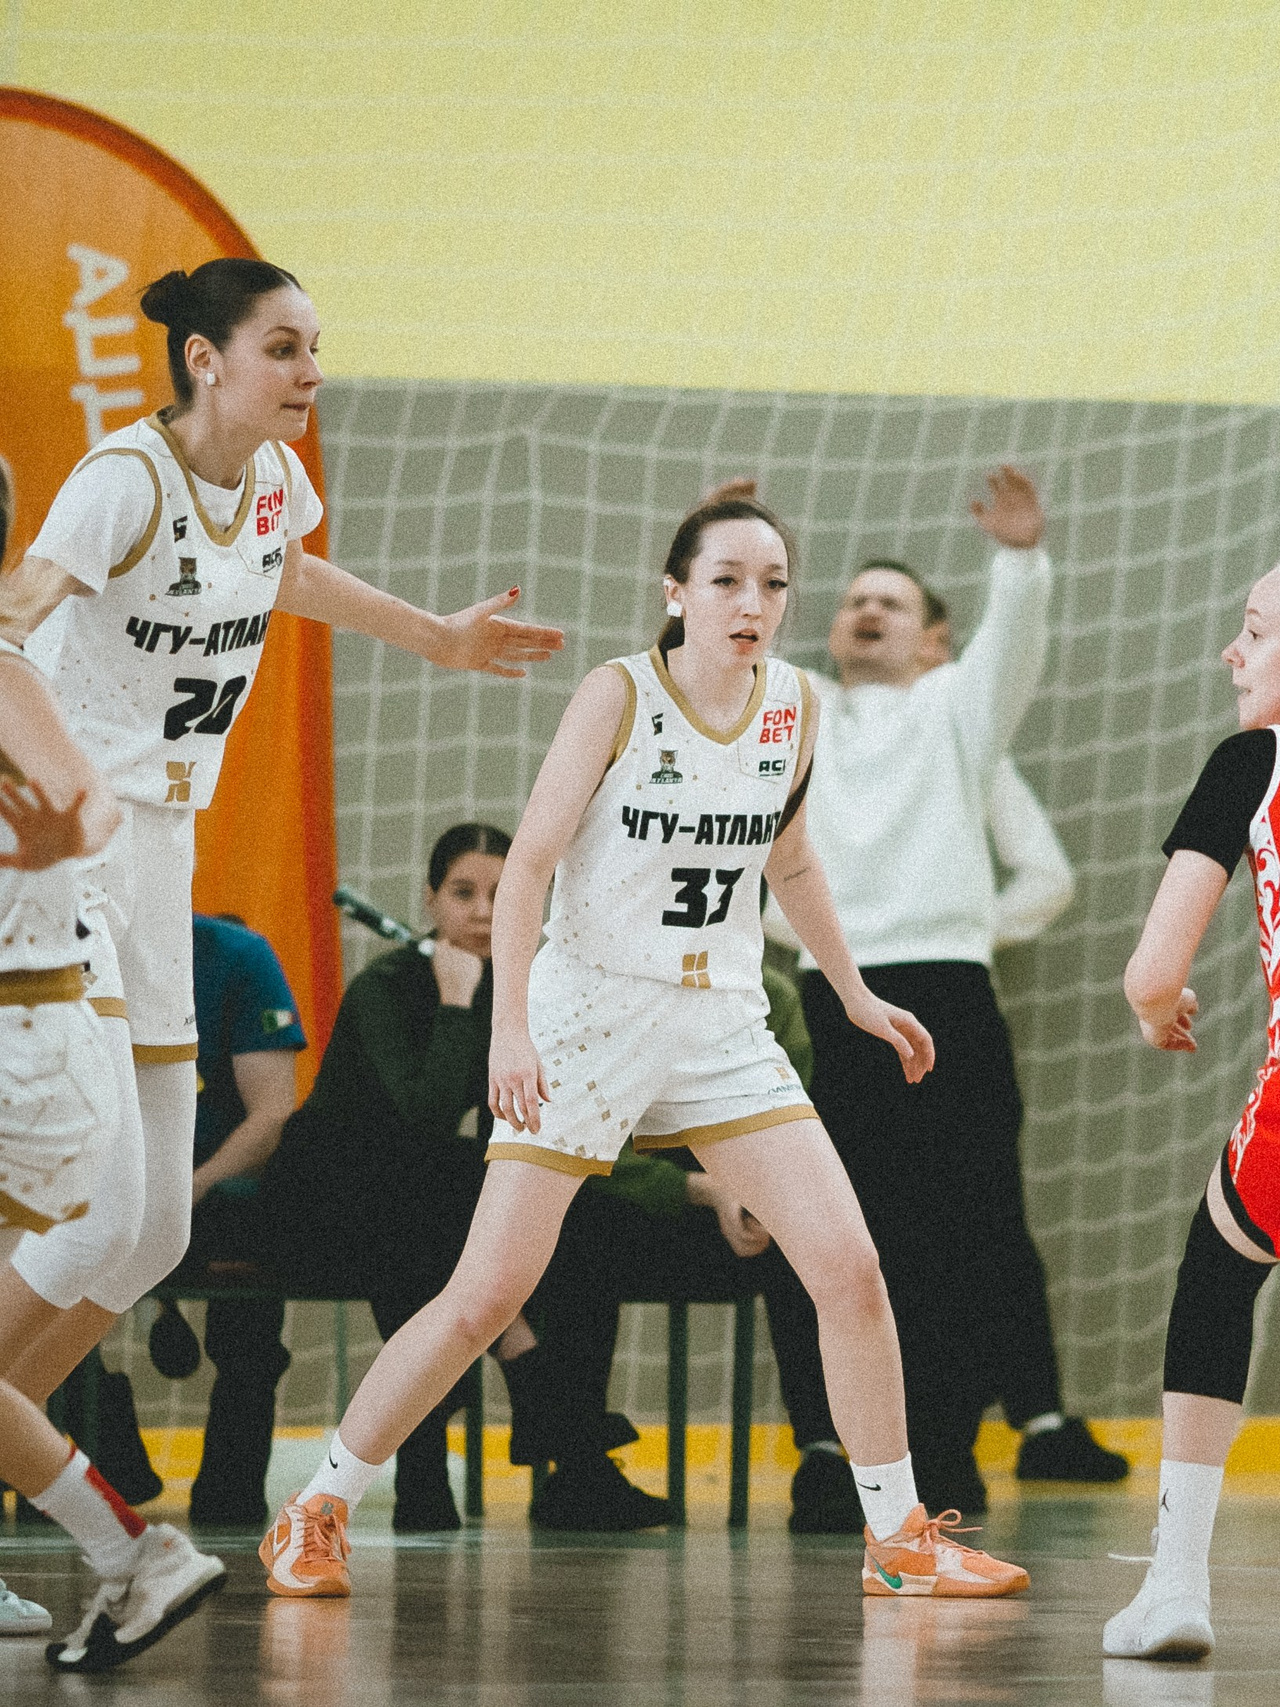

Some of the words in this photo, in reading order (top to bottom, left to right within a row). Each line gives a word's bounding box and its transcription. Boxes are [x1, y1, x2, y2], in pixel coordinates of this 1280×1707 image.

[162, 674, 247, 741] 20
[763, 706, 796, 727] FON
[759, 725, 793, 744] BET
[661, 867, 745, 928] 37
